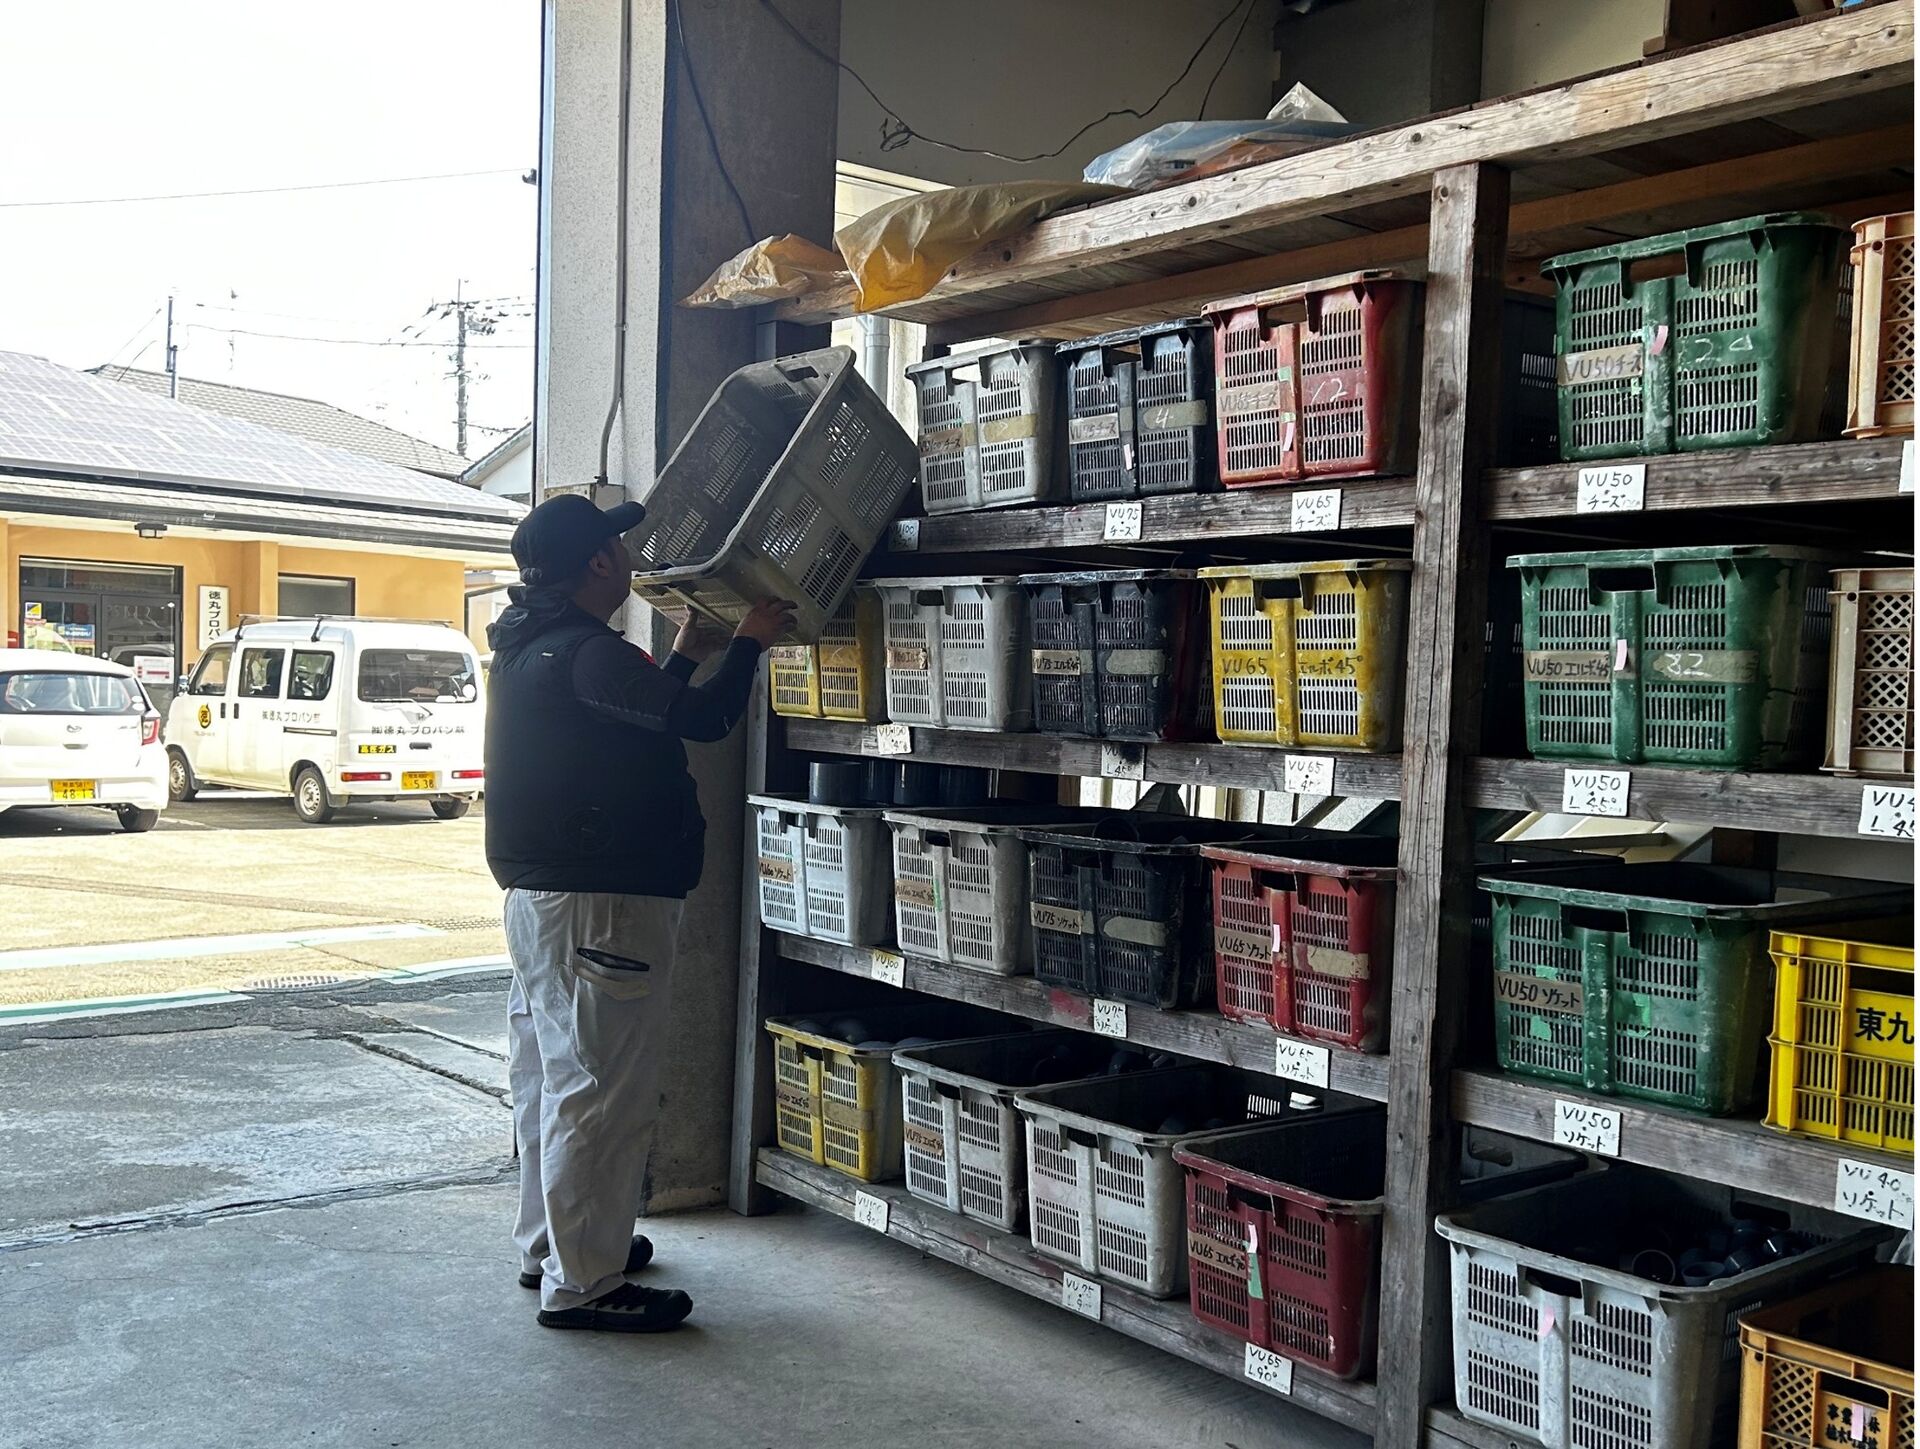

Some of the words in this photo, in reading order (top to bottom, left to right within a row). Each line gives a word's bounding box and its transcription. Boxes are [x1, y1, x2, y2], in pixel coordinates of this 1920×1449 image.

[1584, 472, 1633, 487] VU50
[1296, 495, 1334, 510] VU65
[1587, 494, 1626, 510] チーズ
[1110, 508, 1140, 521] VU75
[1295, 513, 1331, 530] チーズ
[1110, 525, 1136, 537] チーズ
[1222, 656, 1268, 675] VU65
[1527, 658, 1563, 676] VU50
[1288, 760, 1324, 774] VU65
[1571, 775, 1621, 791] VU50
[1034, 910, 1055, 925] VU75
[1217, 935, 1245, 954] VU65
[1498, 976, 1539, 1002] VU50
[1854, 1006, 1914, 1044] 東九
[1562, 1105, 1612, 1130] VU50
[1562, 1130, 1606, 1152] ソケット
[1844, 1164, 1901, 1192] VU40
[1843, 1191, 1905, 1221] ソケット
[1190, 1240, 1214, 1259] VU65
[1249, 1346, 1282, 1368] VU65
